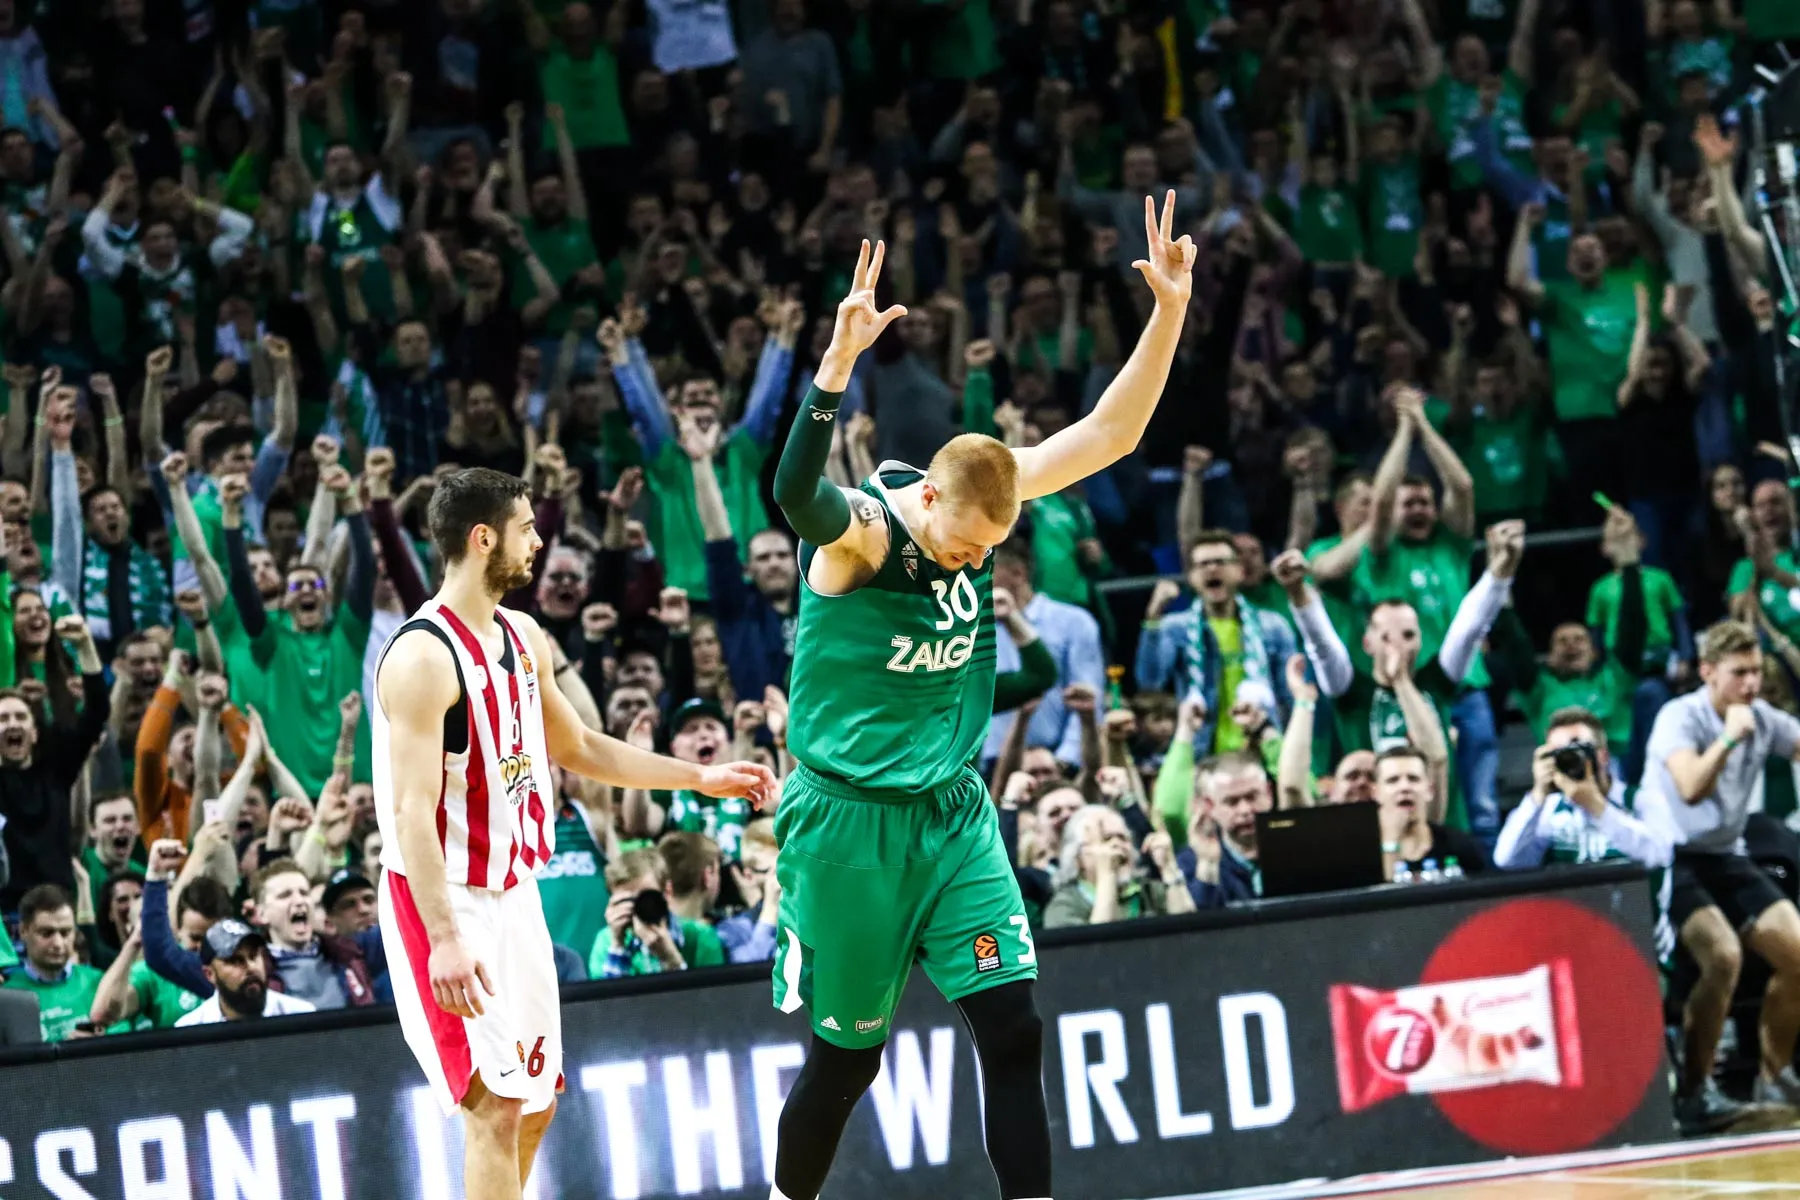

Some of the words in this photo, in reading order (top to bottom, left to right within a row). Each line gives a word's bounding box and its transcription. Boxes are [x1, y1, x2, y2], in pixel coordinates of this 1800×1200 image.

[931, 570, 979, 631] 30
[511, 701, 521, 745] 6
[1009, 914, 1036, 964] 3
[820, 1021, 842, 1032] adidas
[527, 1036, 545, 1077] 6
[0, 1094, 357, 1200] SANT
[868, 991, 1296, 1171] WRLD
